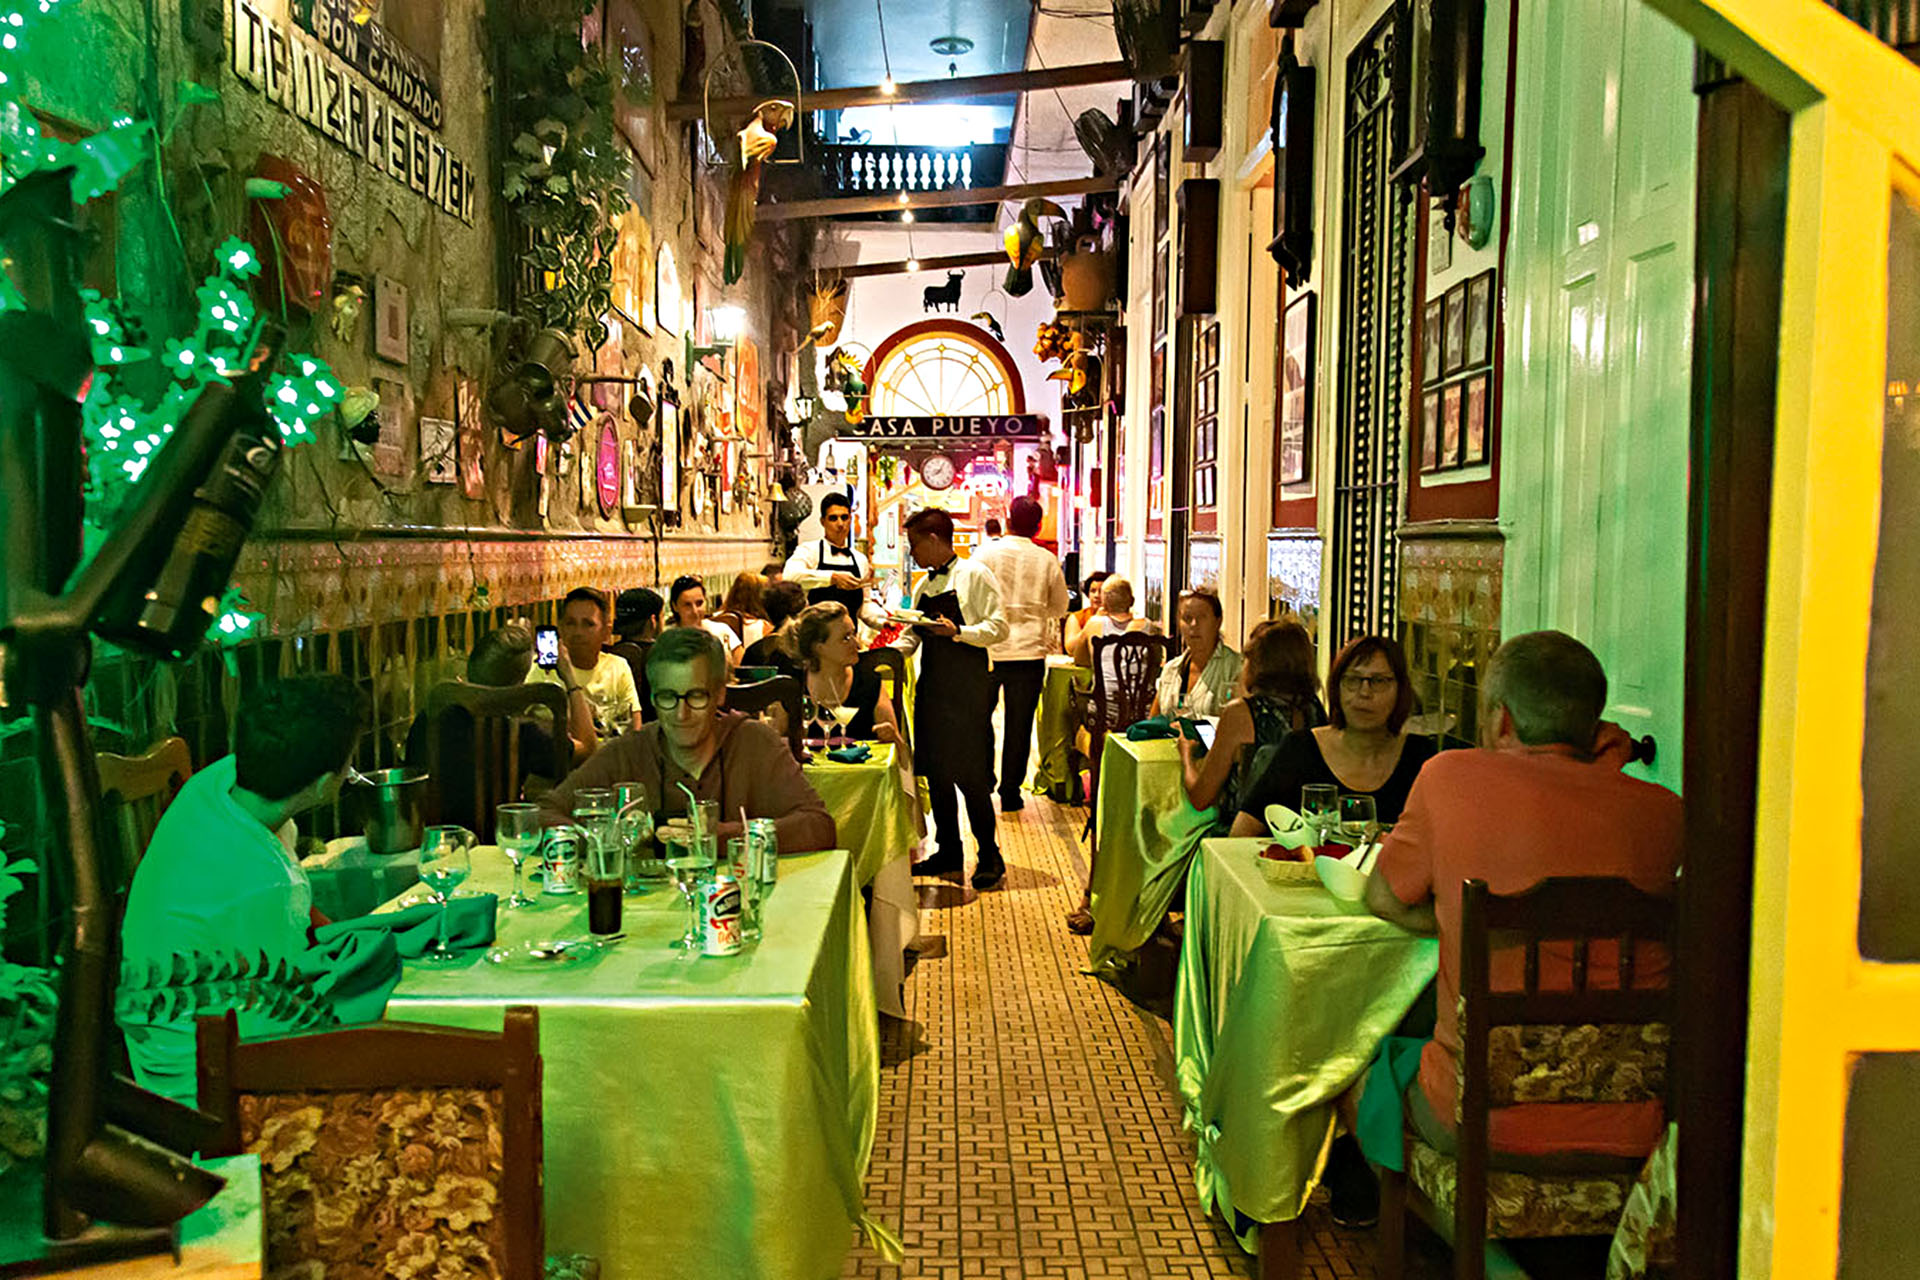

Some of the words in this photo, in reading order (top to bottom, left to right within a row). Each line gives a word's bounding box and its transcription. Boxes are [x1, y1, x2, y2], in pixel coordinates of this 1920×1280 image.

[368, 47, 442, 127] CANDADO
[370, 21, 428, 88] BLANCA
[932, 417, 1023, 435] PUEYO
